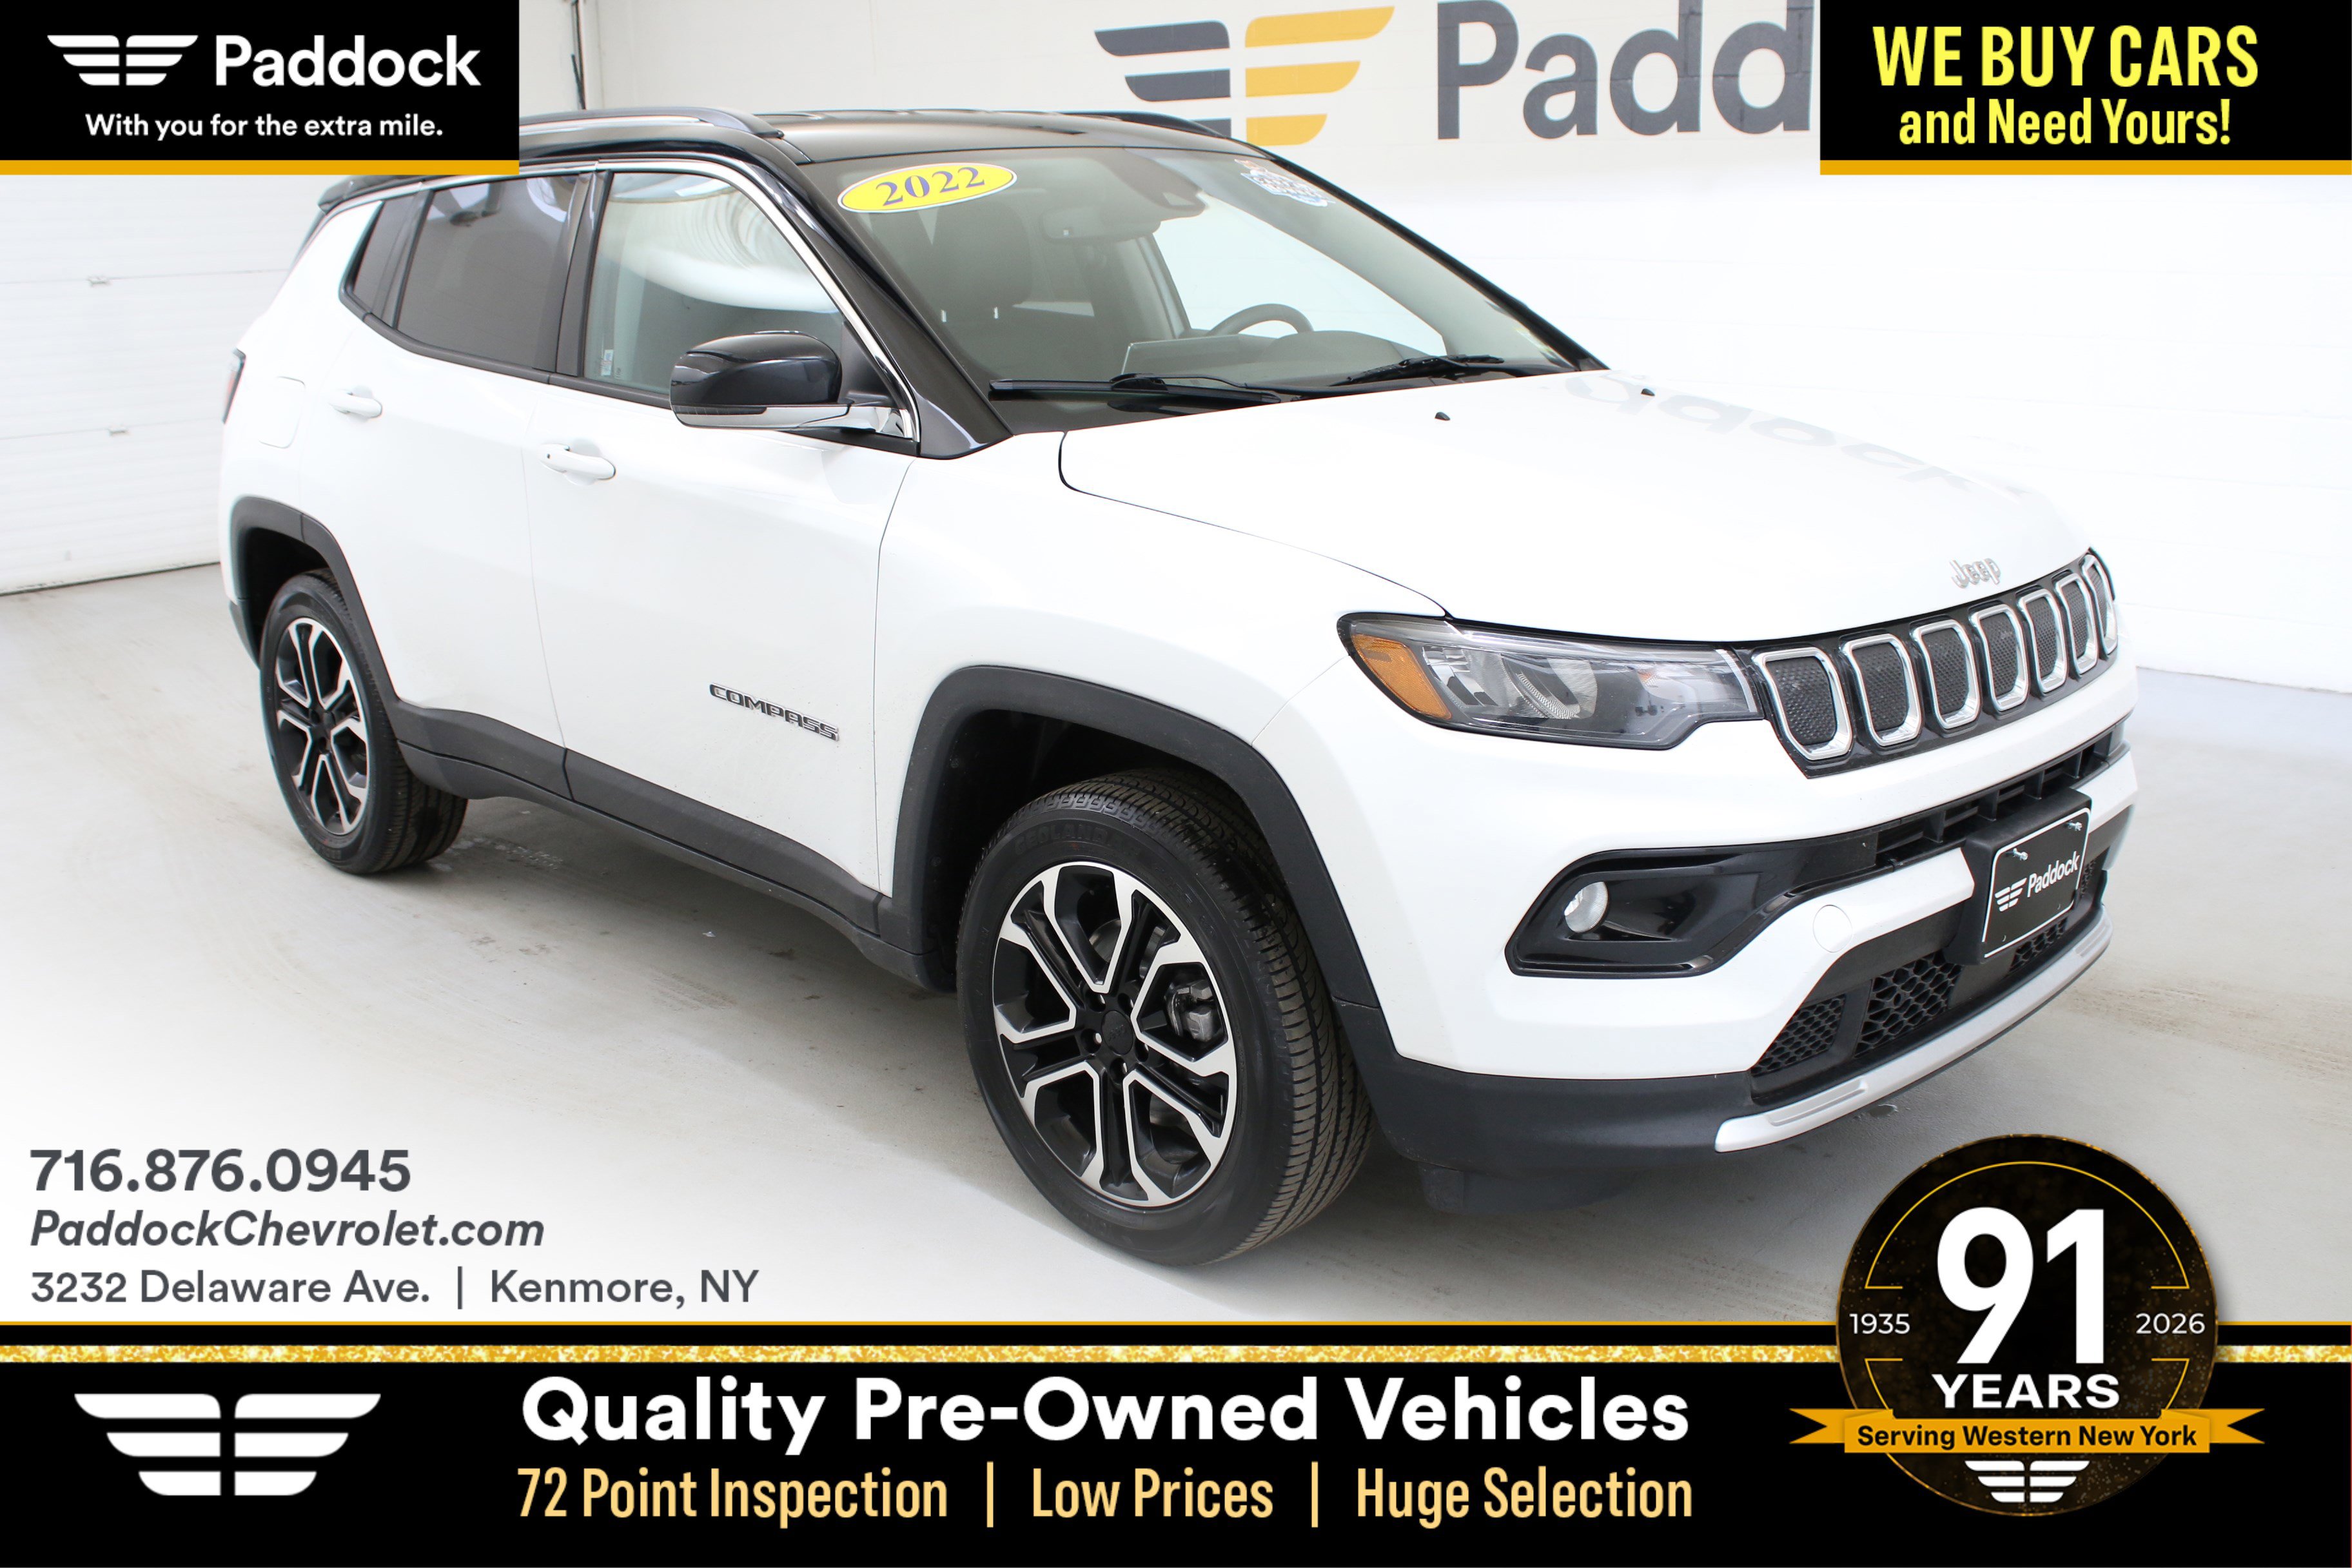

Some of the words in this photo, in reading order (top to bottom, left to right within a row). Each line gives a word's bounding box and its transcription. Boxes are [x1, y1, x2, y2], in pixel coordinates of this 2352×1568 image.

[876, 166, 985, 206] 2022
[1949, 558, 2001, 589] Jeep
[709, 683, 839, 741] COMPASS
[2027, 850, 2081, 898] Paddock
